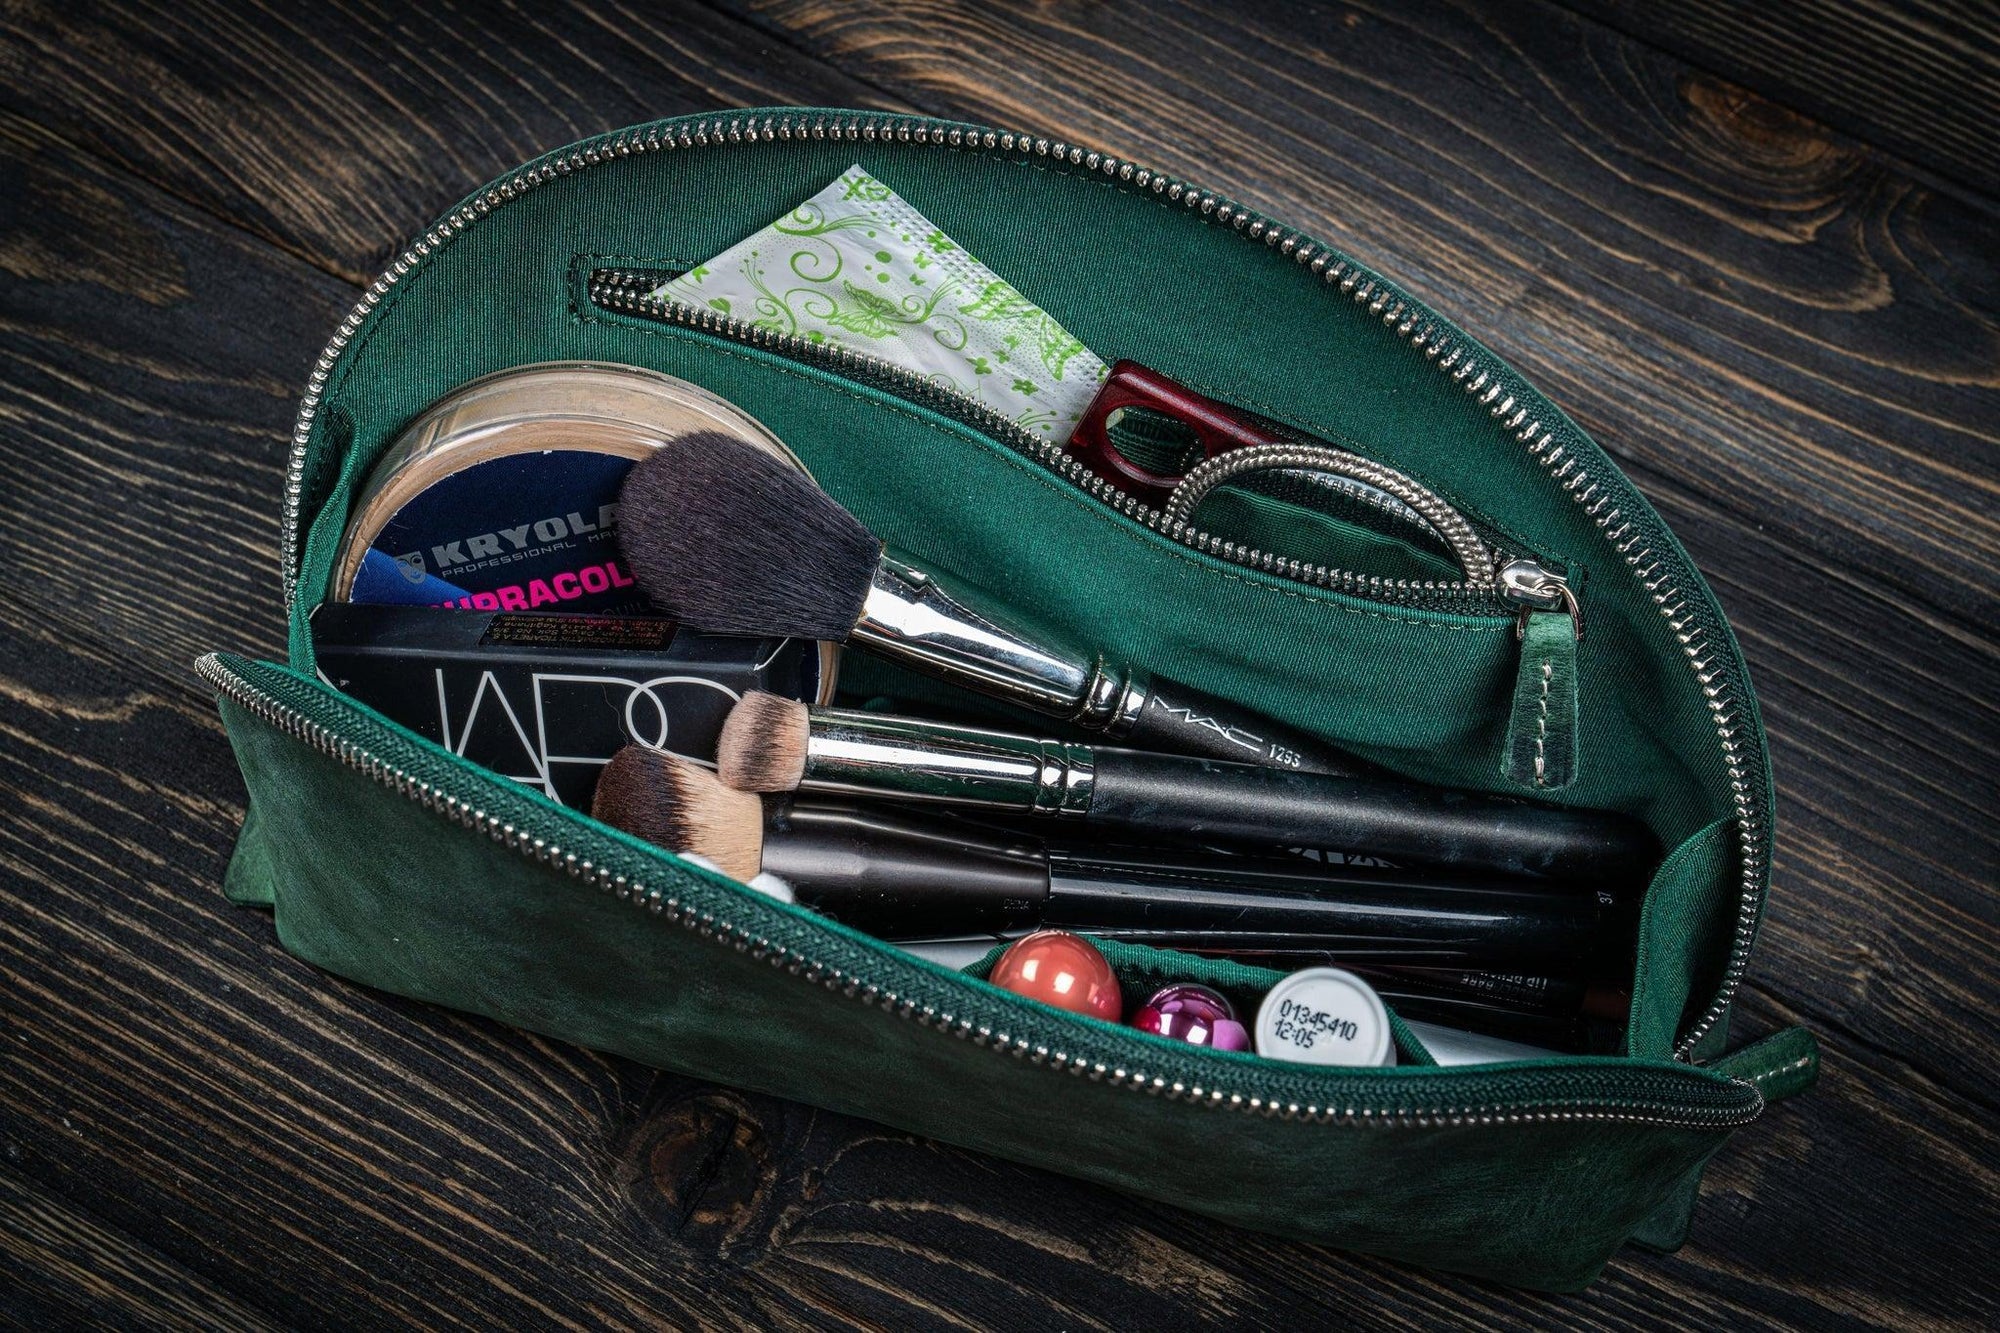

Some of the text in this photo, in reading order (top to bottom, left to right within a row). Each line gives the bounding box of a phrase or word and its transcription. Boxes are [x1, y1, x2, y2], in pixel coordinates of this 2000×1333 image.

[431, 502, 622, 569] KRYOLA
[441, 540, 577, 579] PROFESSIONAL
[1275, 1019, 1318, 1048] 12:05
[1280, 999, 1358, 1041] 01345410
